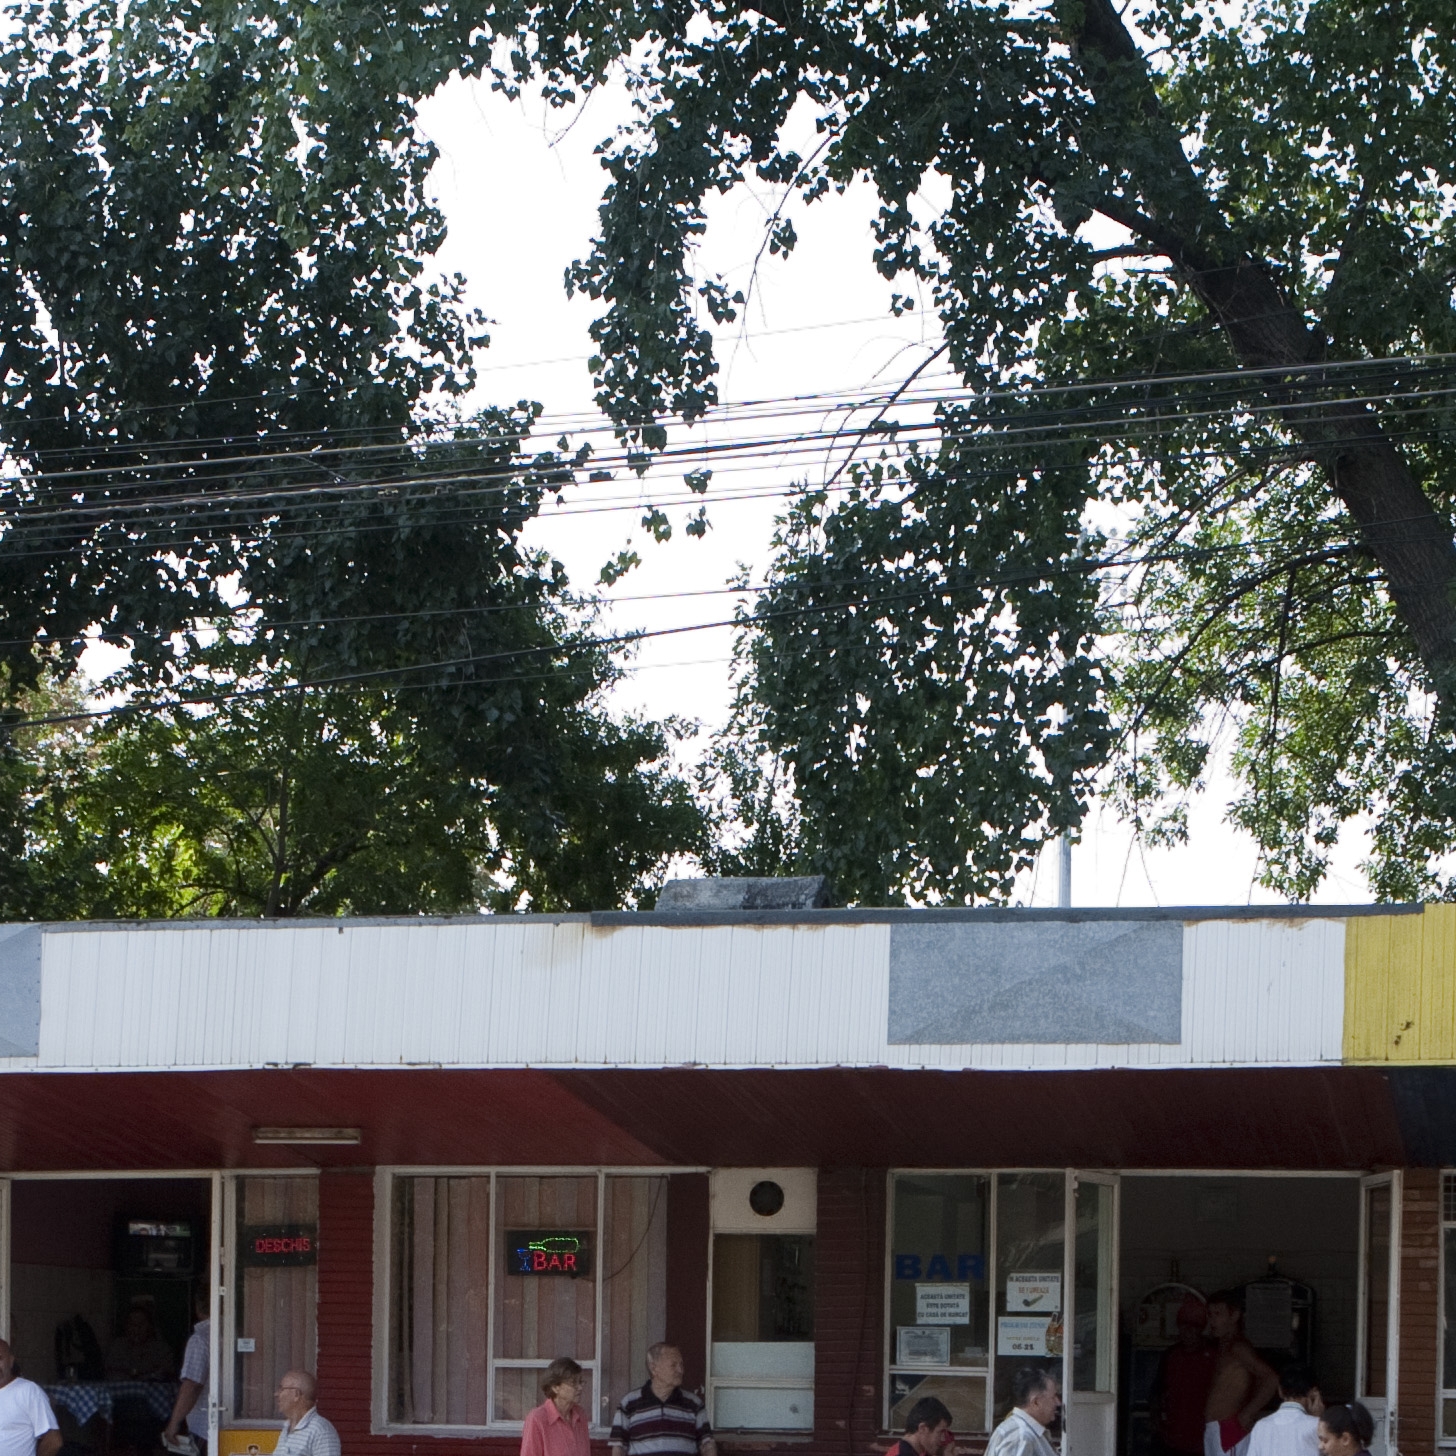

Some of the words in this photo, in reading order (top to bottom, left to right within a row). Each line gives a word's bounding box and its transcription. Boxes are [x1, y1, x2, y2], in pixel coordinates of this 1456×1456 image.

[255, 1238, 310, 1253] DESCHIS
[533, 1251, 577, 1271] BAR
[895, 1254, 985, 1280] BAR
